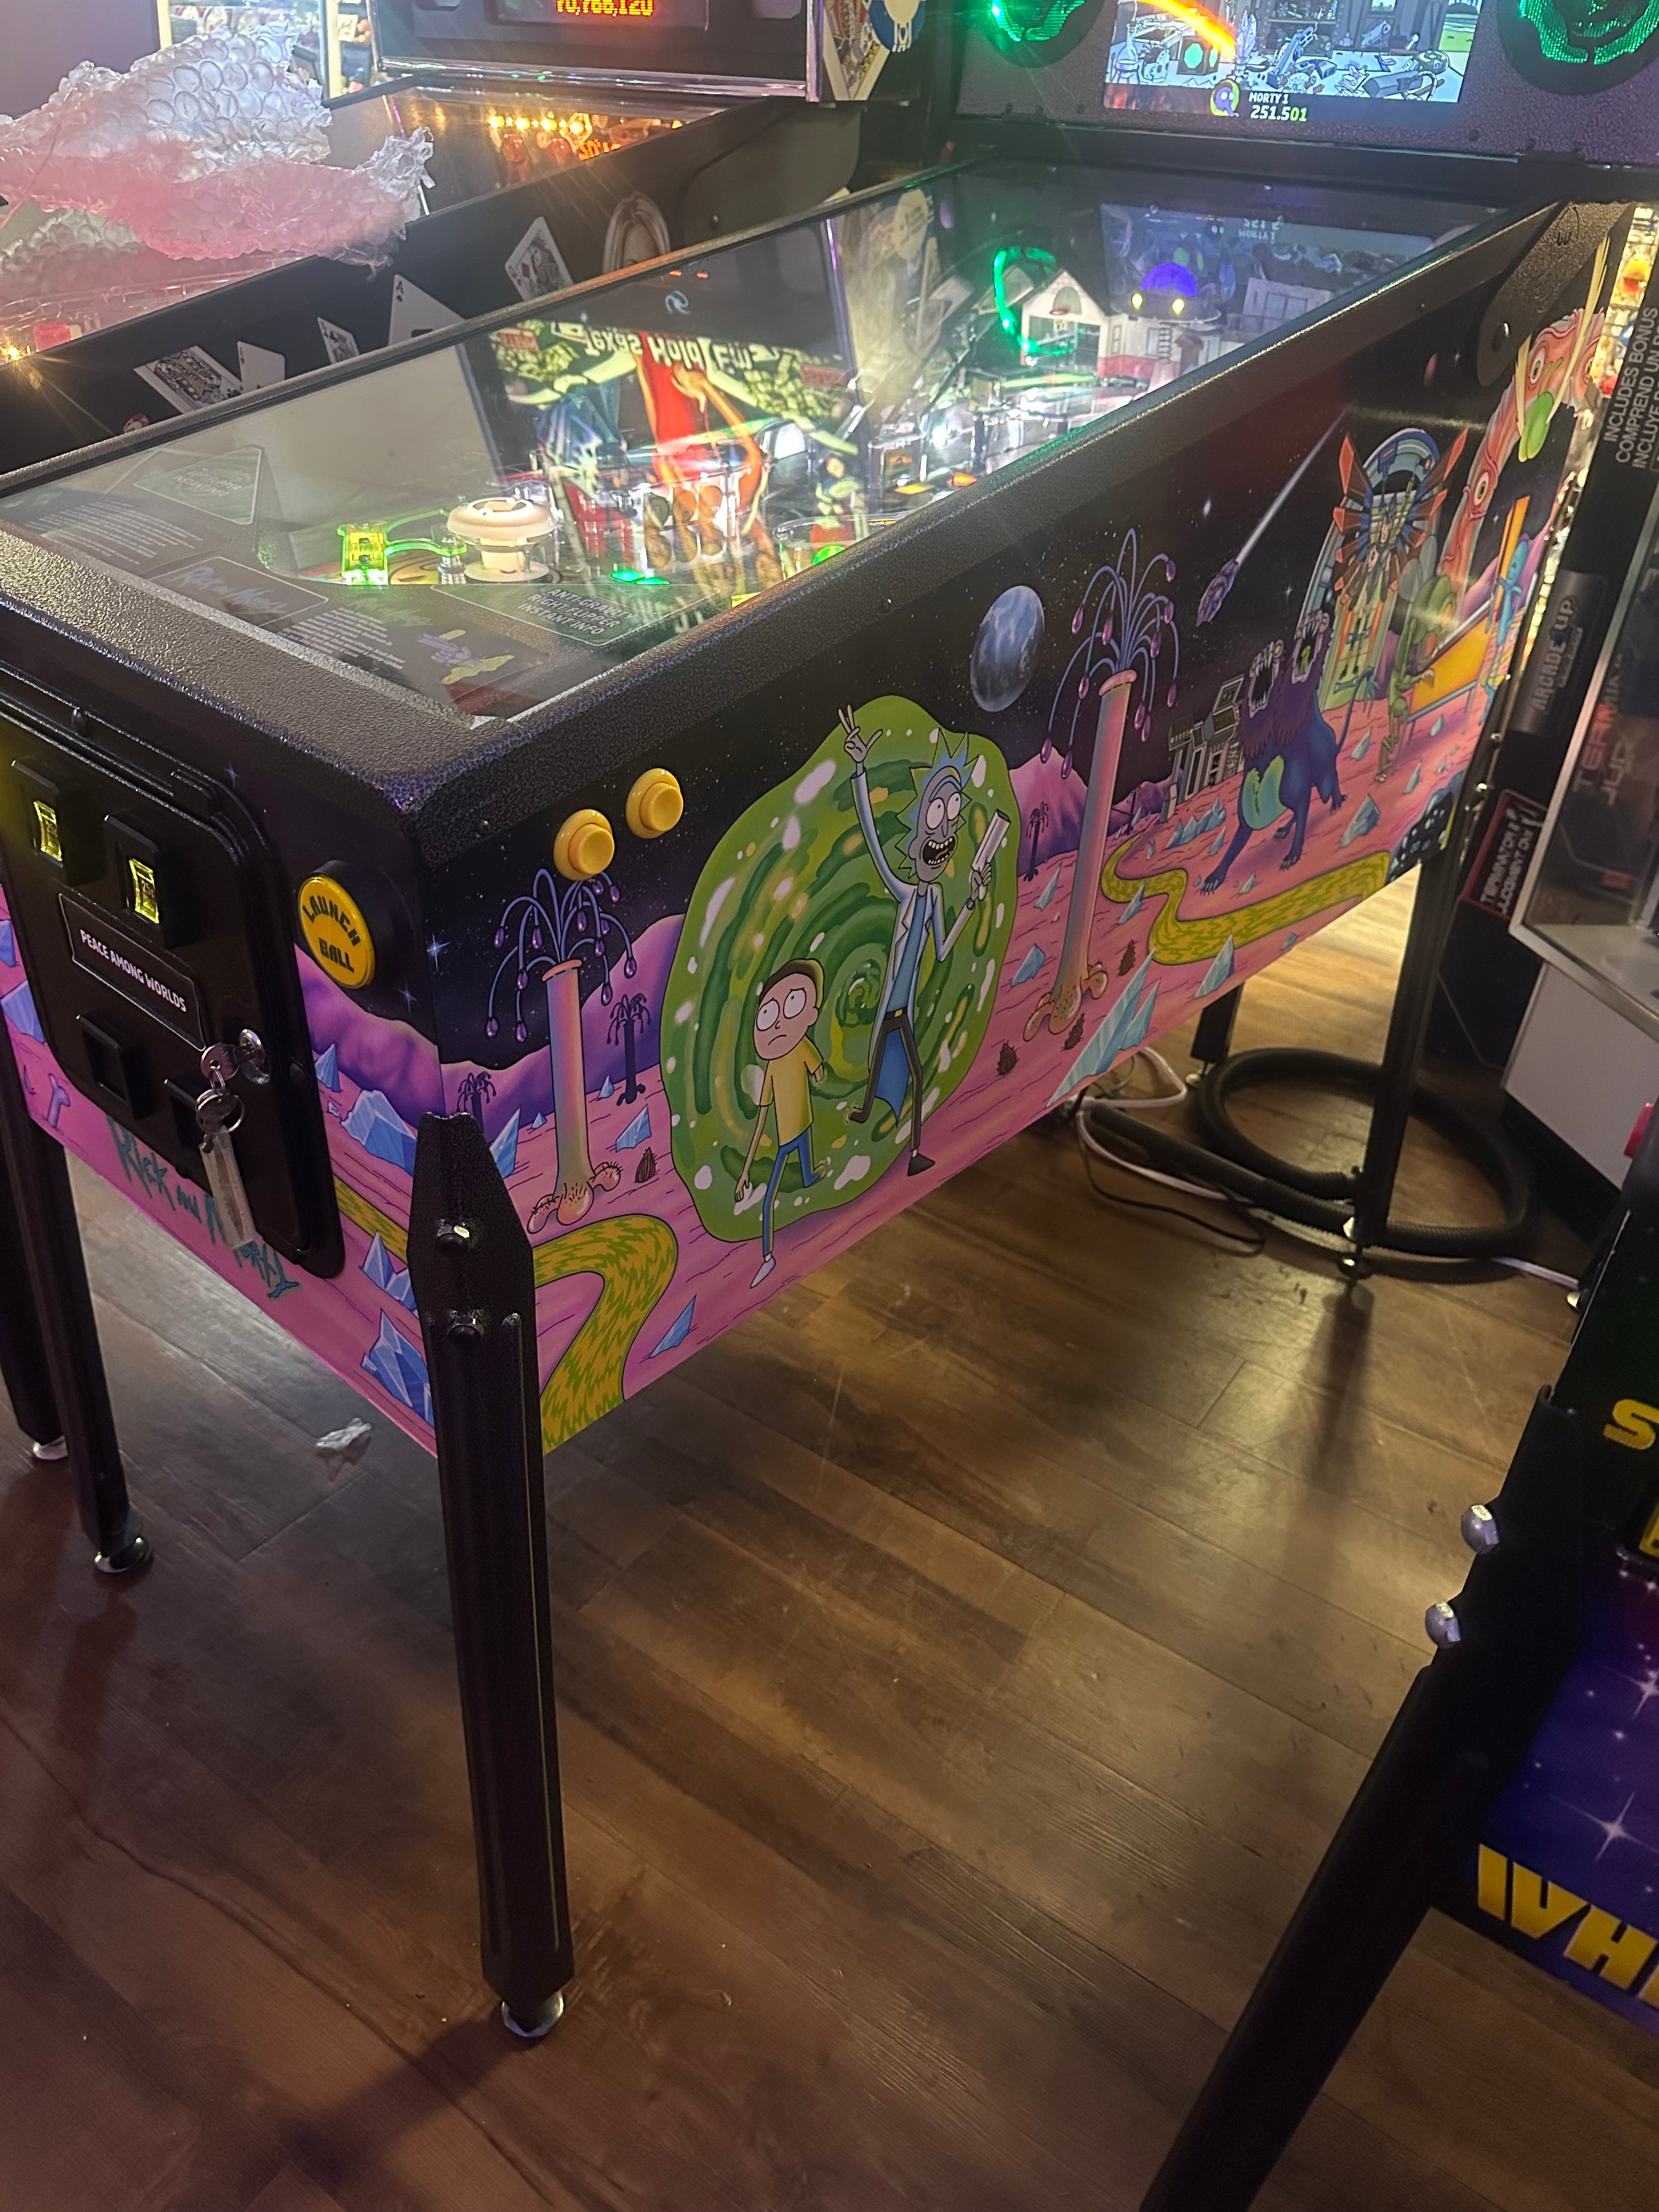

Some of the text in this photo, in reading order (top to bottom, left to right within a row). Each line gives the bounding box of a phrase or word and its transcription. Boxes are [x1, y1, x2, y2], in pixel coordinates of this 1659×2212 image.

[1249, 92, 1289, 104] MORTY 1
[1603, 307, 1658, 442] INCLUDES BONUS
[1616, 376, 1655, 463] COMPREND
[517, 602, 606, 635] INSTANT INFO
[528, 594, 620, 628] RIGHT FLIPPER
[547, 588, 637, 620] ANTI-GRAVITY
[302, 895, 362, 947] LAUNCH
[80, 929, 187, 1013] PEACE AMONG WORLDS
[318, 937, 354, 973] BALL
